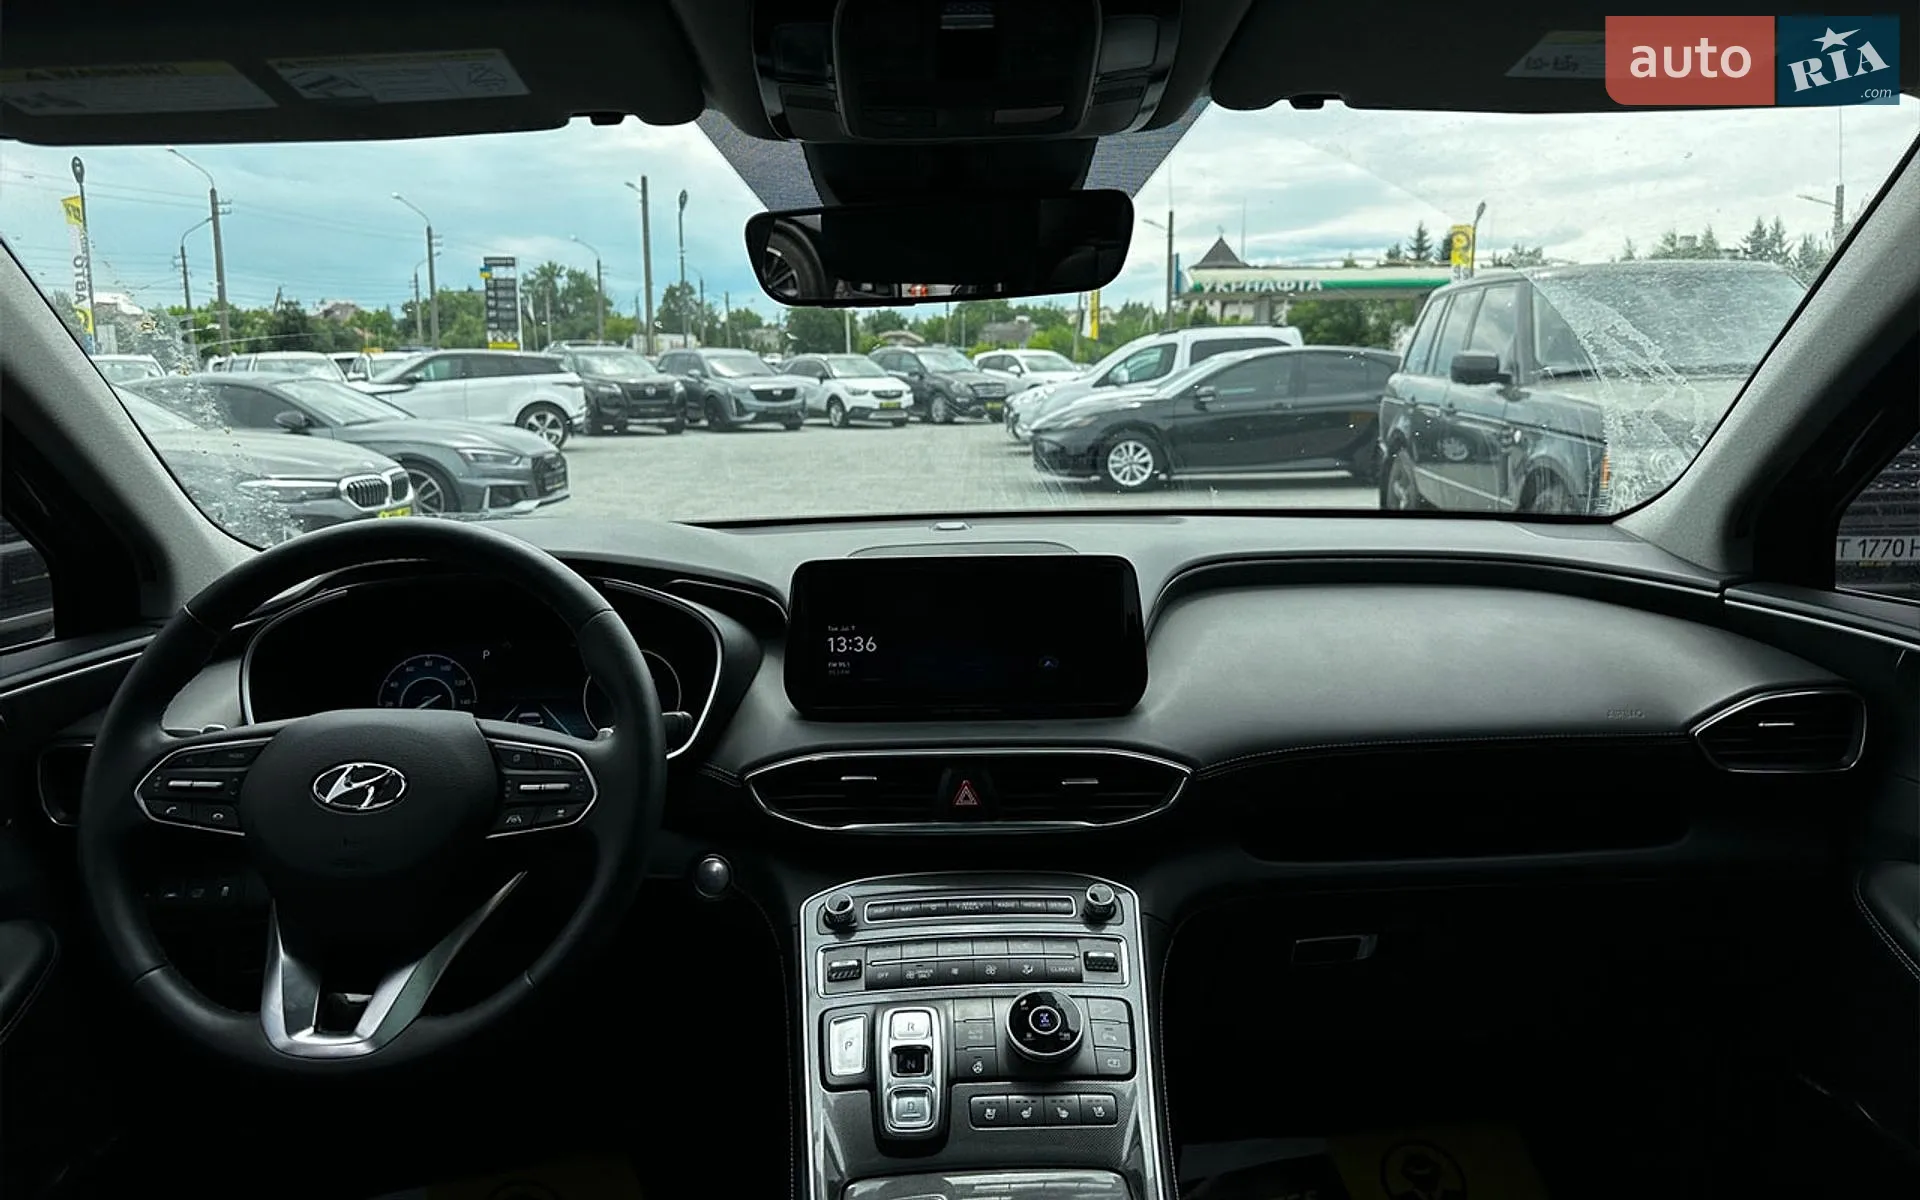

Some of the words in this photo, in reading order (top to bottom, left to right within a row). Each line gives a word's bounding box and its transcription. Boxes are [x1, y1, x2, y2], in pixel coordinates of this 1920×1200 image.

[1201, 279, 1323, 293] УКРНАФТА
[1858, 538, 1905, 558] 1770
[827, 636, 877, 653] 13:36
[482, 649, 491, 660] P
[906, 1022, 915, 1032] R
[844, 1040, 853, 1051] P
[906, 1060, 916, 1070] N
